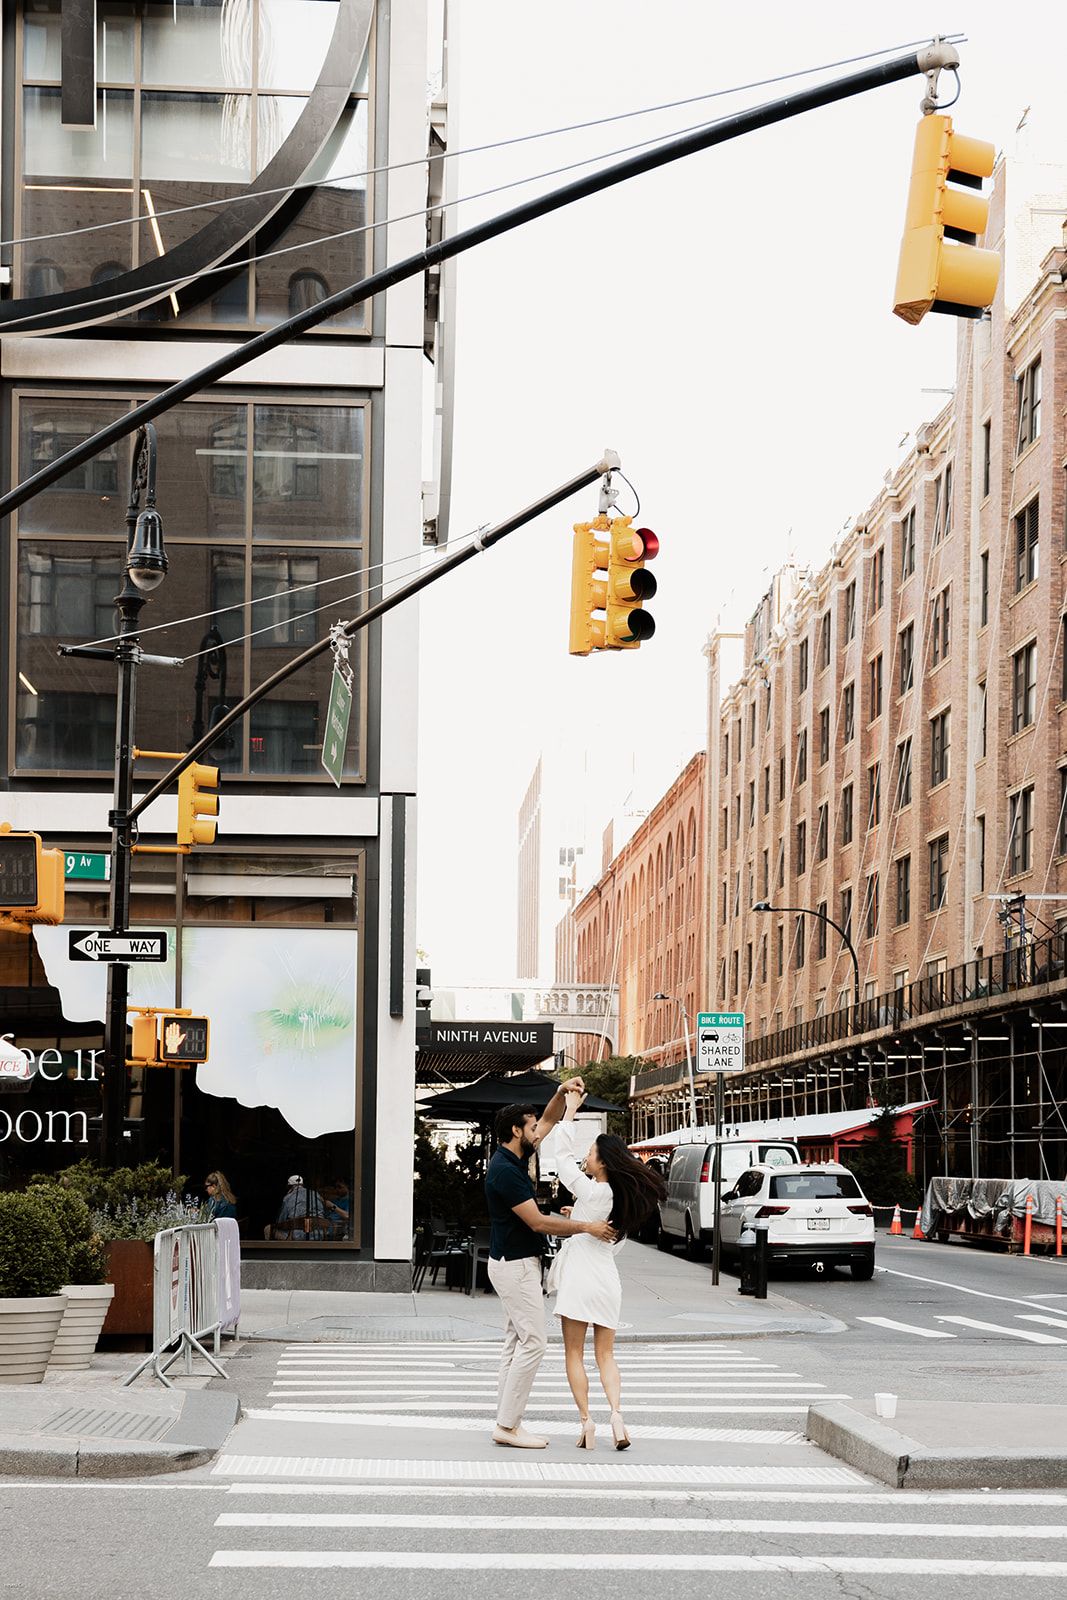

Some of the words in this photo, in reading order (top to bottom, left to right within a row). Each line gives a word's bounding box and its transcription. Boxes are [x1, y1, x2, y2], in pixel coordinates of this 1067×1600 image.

[66, 856, 75, 874] 9
[80, 855, 92, 867] Av
[85, 940, 111, 952] ONE
[129, 940, 157, 953] WAY
[701, 1016, 716, 1024] BIKE
[719, 1016, 741, 1024] ROUTE
[437, 1030, 478, 1042] NINTH
[483, 1031, 537, 1043] AVENUE
[701, 1046, 741, 1055] SHARED
[707, 1058, 733, 1066] LANE
